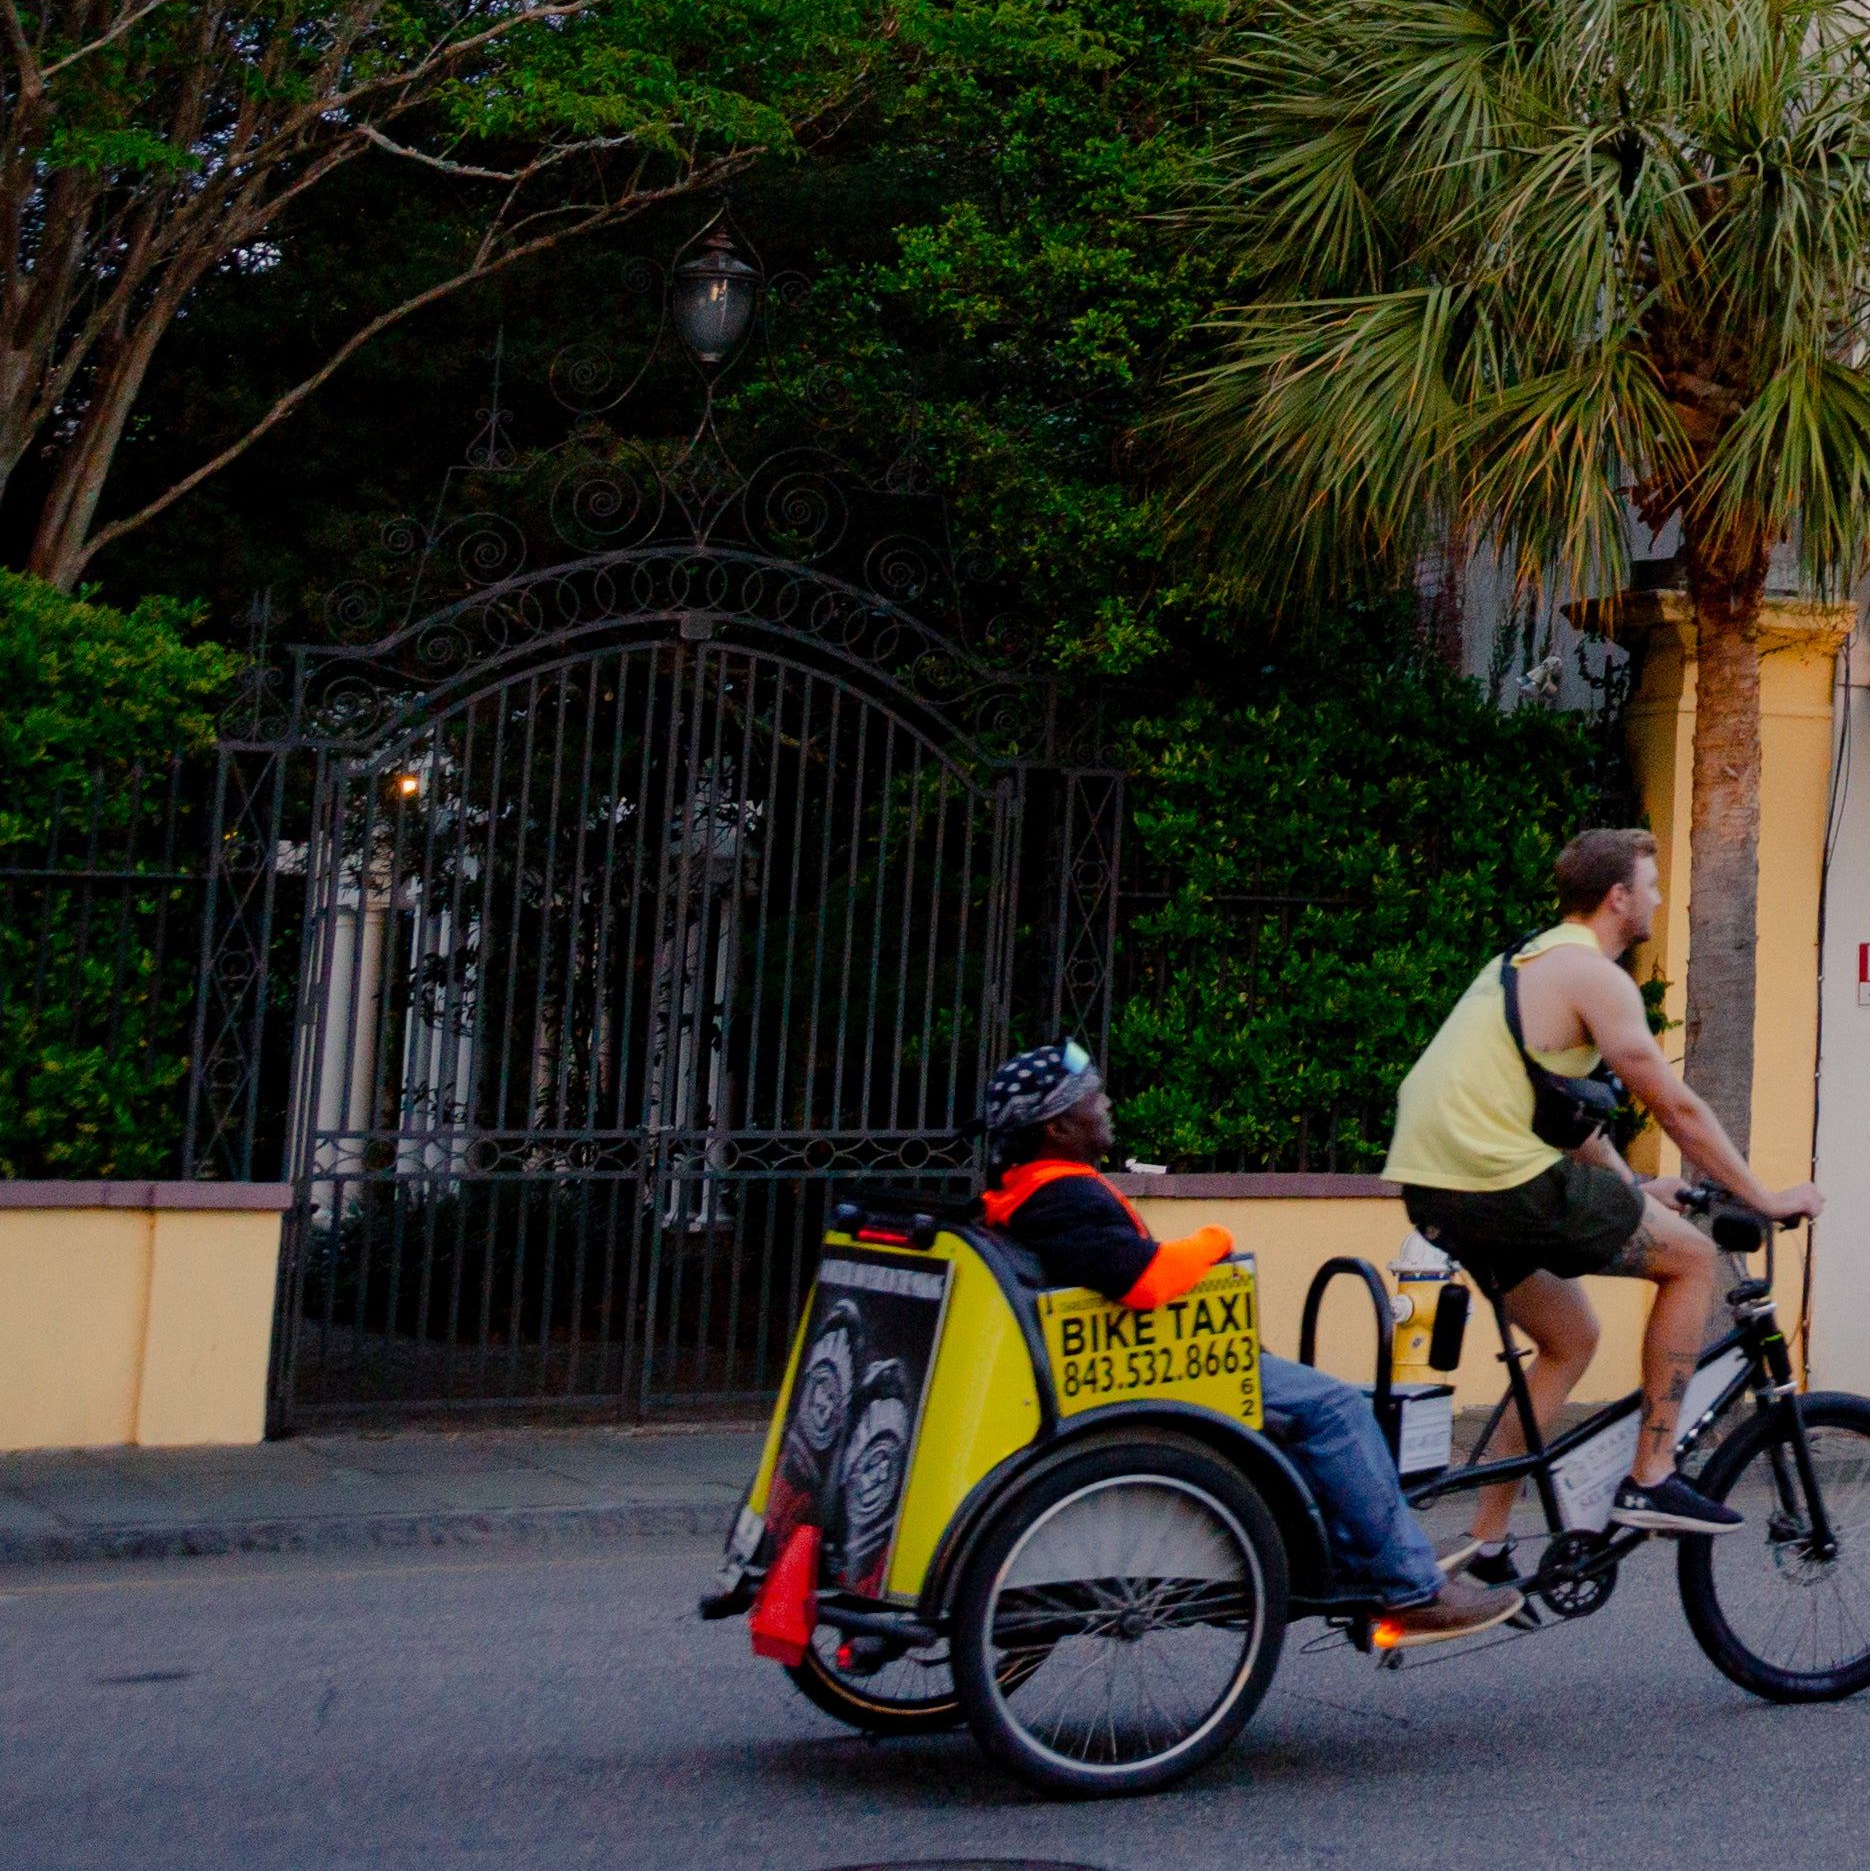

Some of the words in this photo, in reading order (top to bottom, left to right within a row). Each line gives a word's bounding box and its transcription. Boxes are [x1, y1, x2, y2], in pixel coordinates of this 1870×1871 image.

[1061, 1308, 1155, 1357] BIKE
[1166, 1291, 1253, 1340] TAXI
[1063, 1335, 1254, 1397] 843.532.8663
